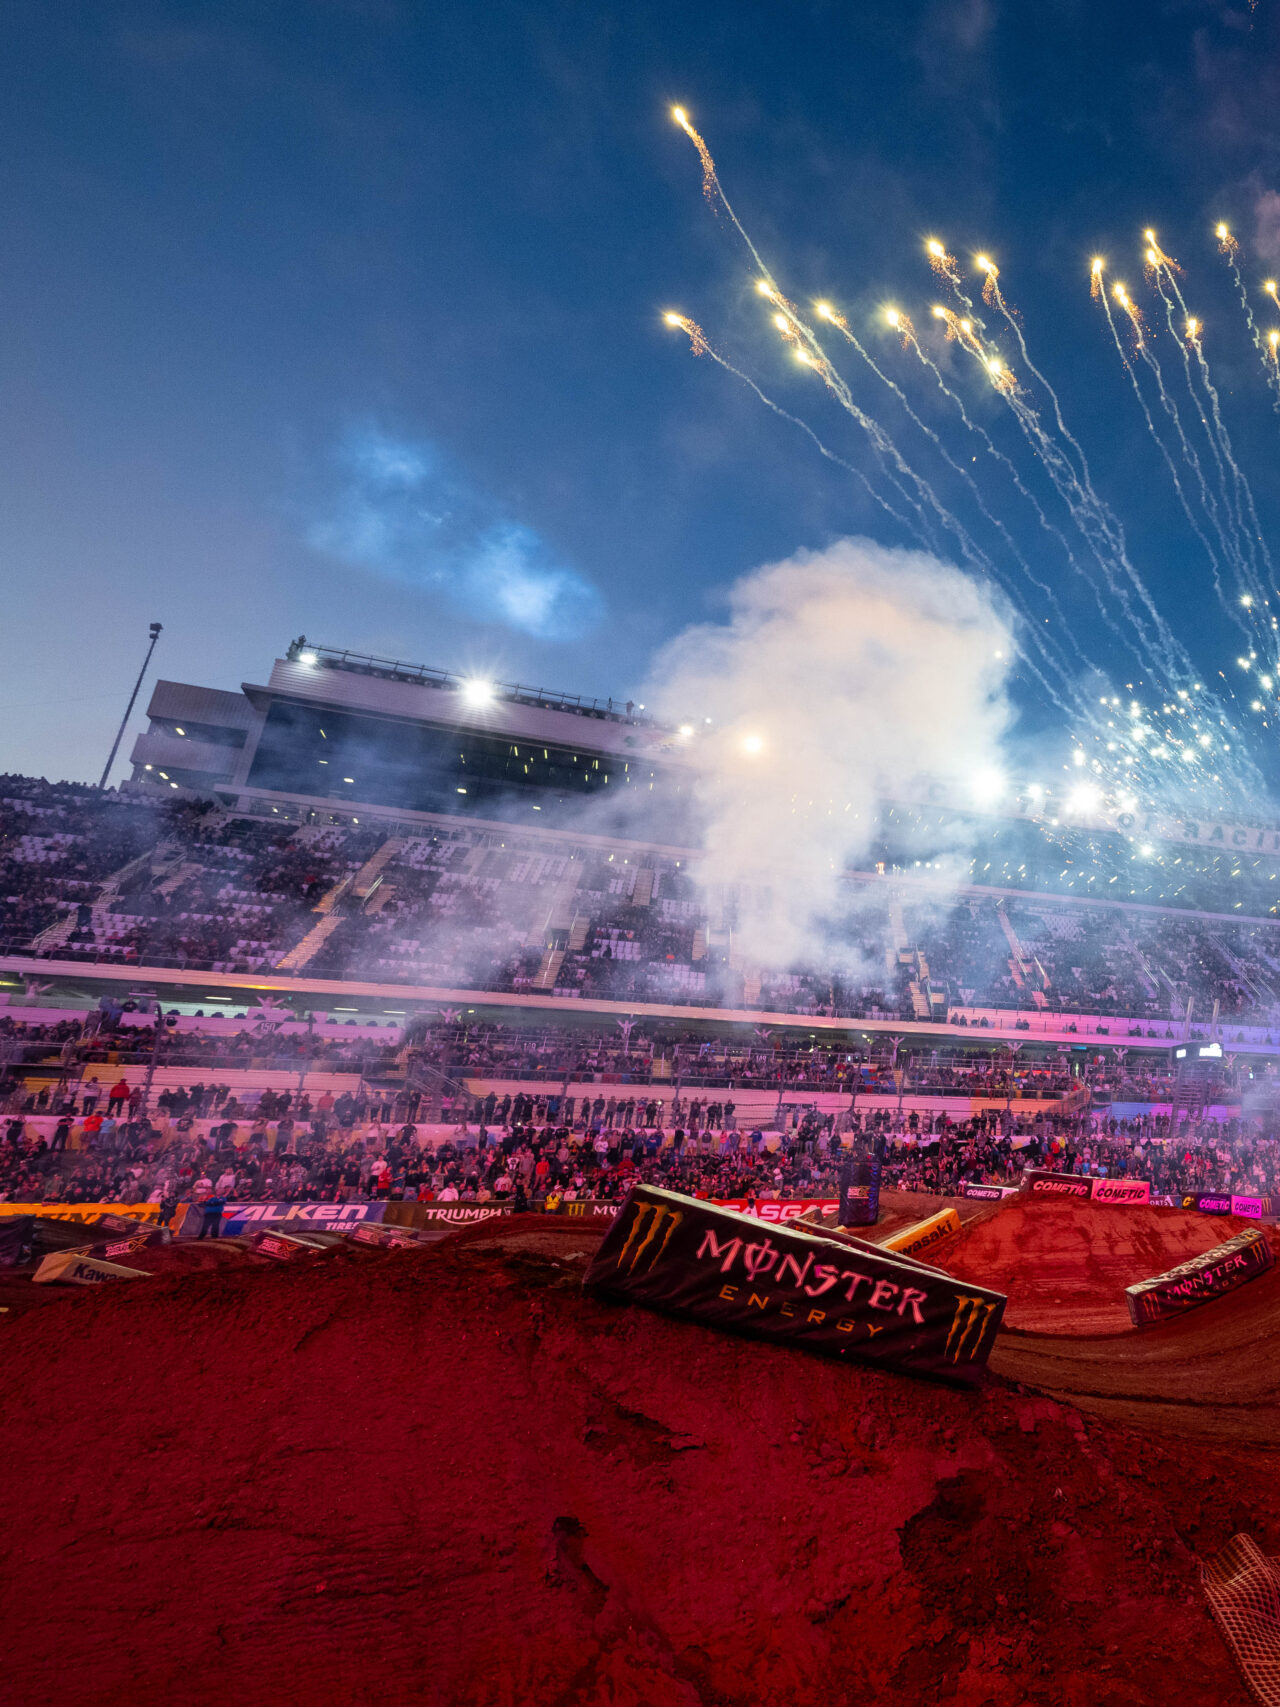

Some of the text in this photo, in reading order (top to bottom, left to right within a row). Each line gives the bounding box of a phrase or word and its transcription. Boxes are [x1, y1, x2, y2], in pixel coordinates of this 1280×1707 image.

[966, 1188, 1000, 1199] COMETIC
[1033, 1180, 1145, 1199] COMETIC COMETIC
[222, 1205, 369, 1222] FALKEN
[1200, 1198, 1260, 1214] COMETIC COMETIC
[425, 1208, 502, 1225] TRIUMPH
[696, 1229, 929, 1325] MONSTER
[1166, 1254, 1248, 1300] MONSTER
[718, 1283, 885, 1339] ENERGY
